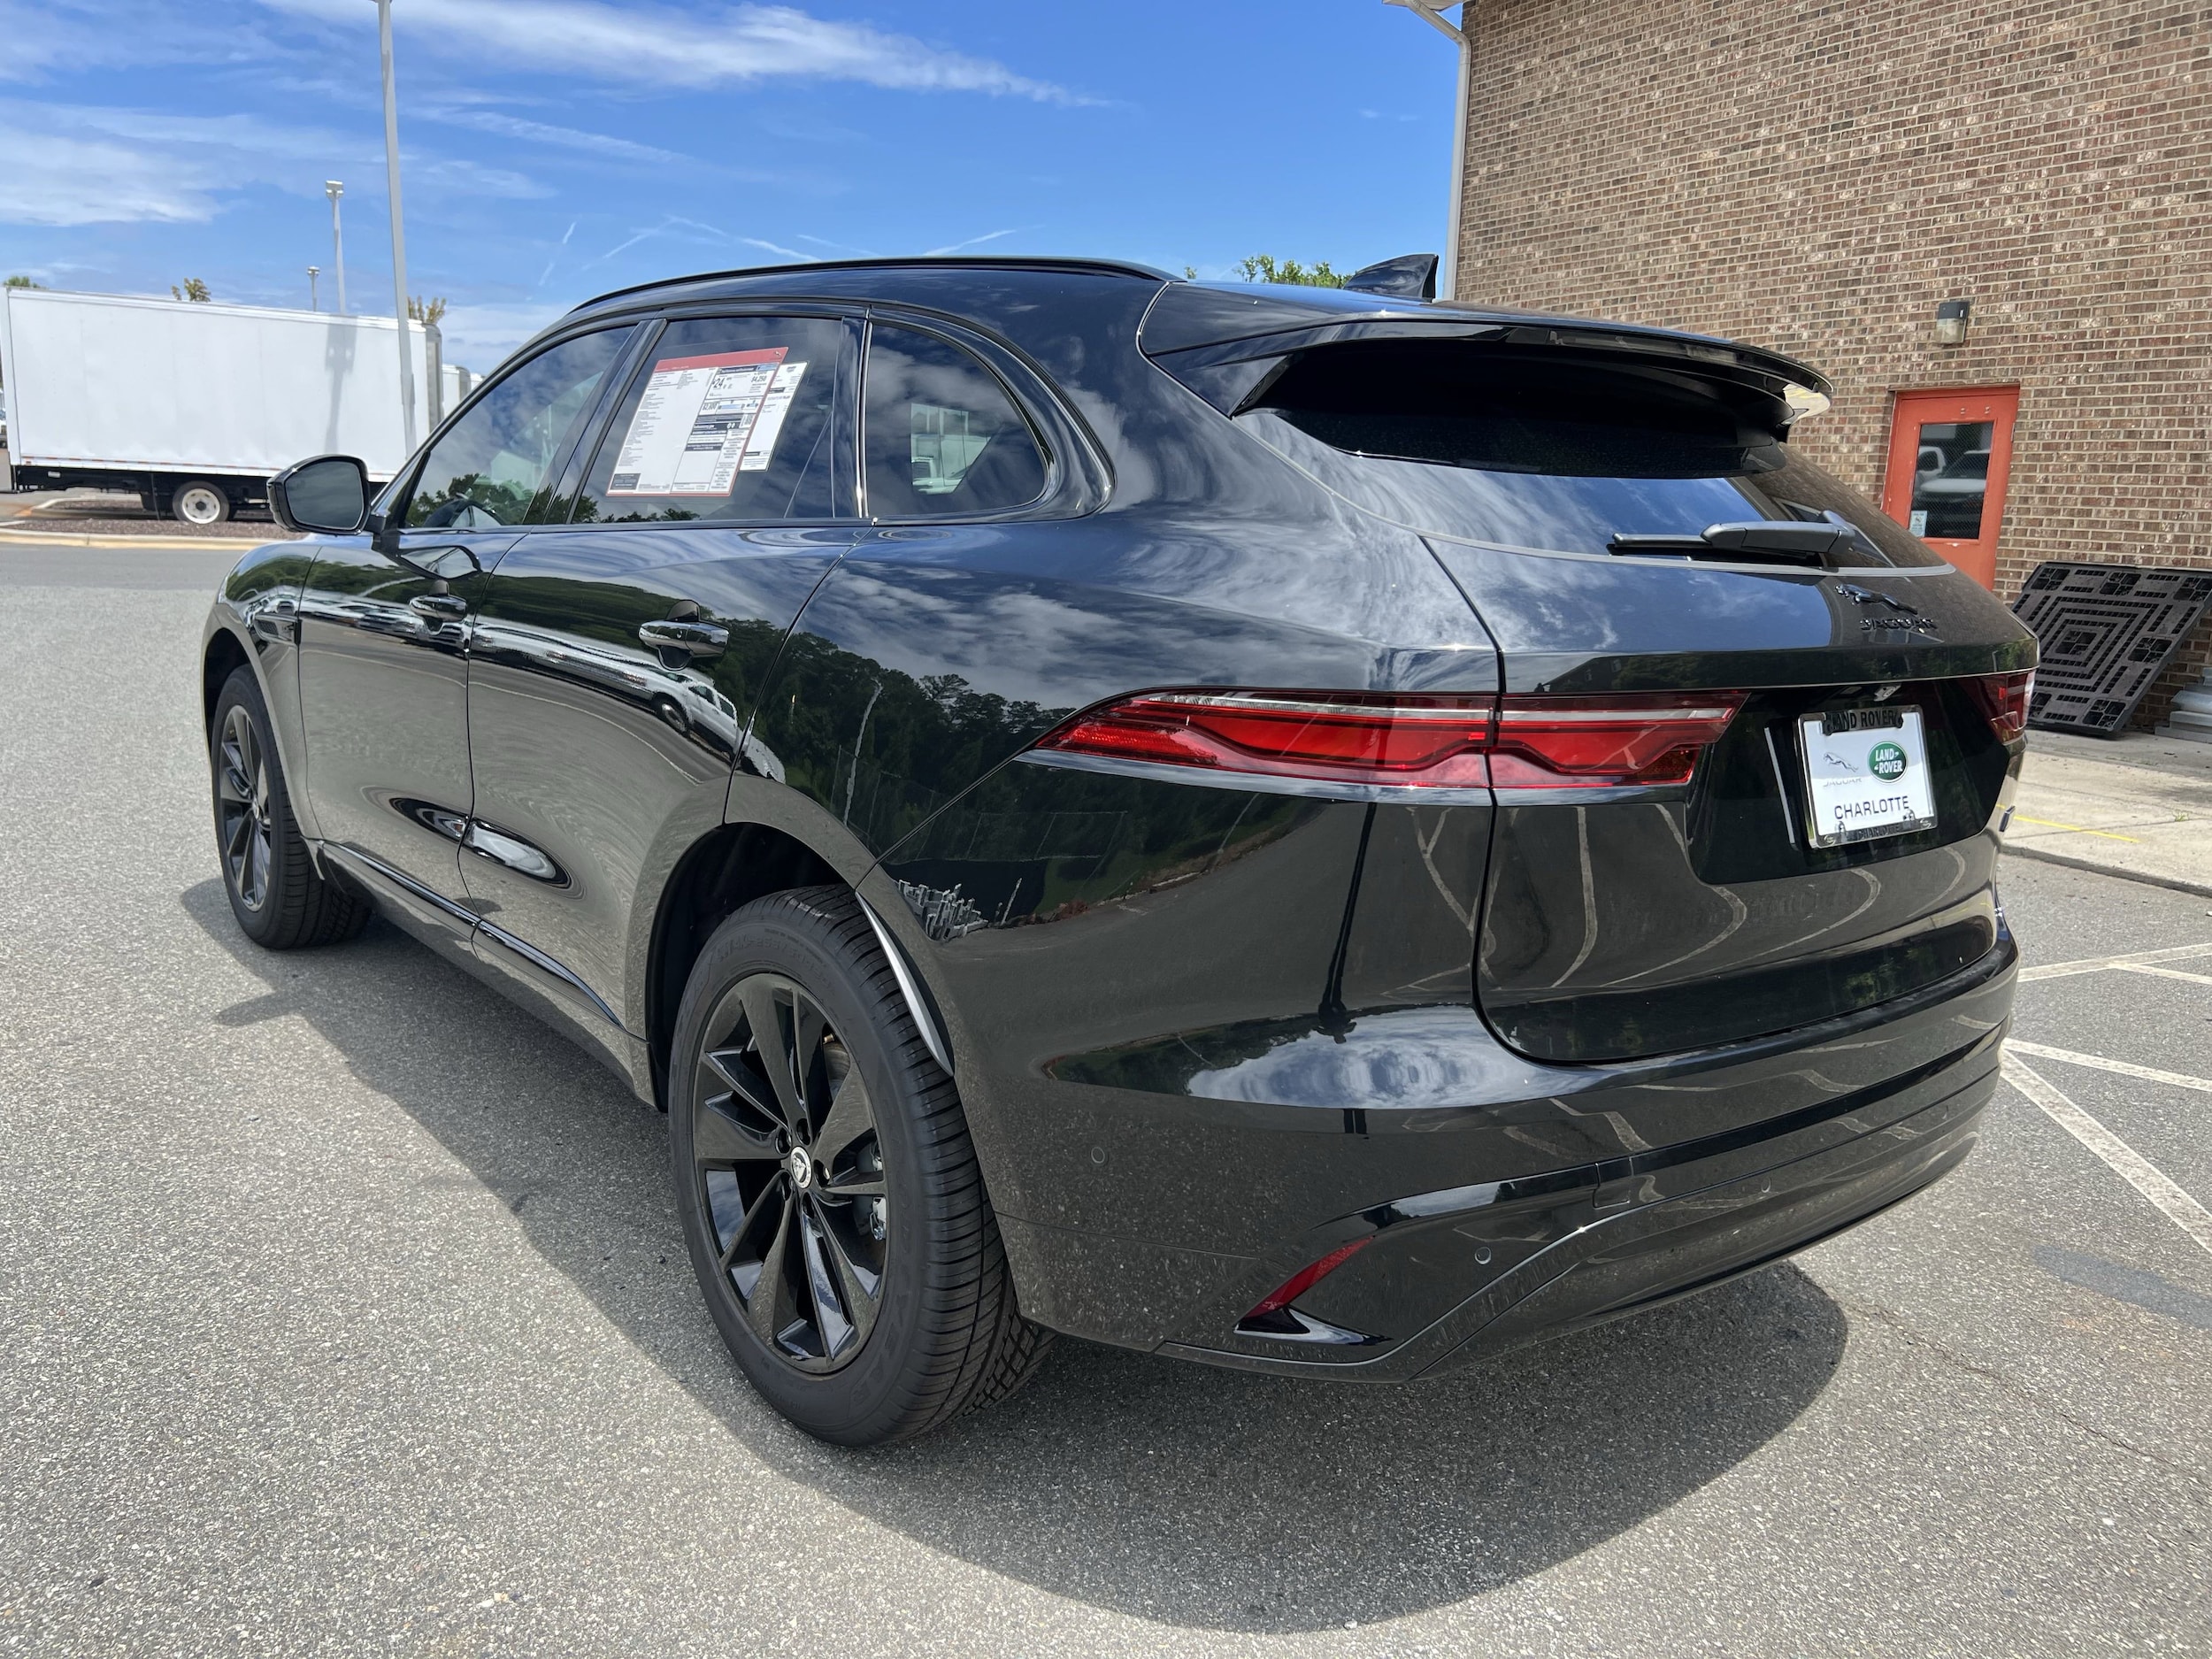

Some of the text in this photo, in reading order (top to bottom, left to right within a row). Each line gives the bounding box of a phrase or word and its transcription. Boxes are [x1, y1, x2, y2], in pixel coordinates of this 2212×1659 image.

[1860, 618, 1938, 631] JAGUAR
[1861, 710, 1895, 726] ROVER
[1875, 748, 1894, 762] LAND
[1878, 760, 1902, 774] ROVER
[1823, 778, 1862, 787] JAGUAR
[1834, 795, 1909, 819] CHARLOTTE
